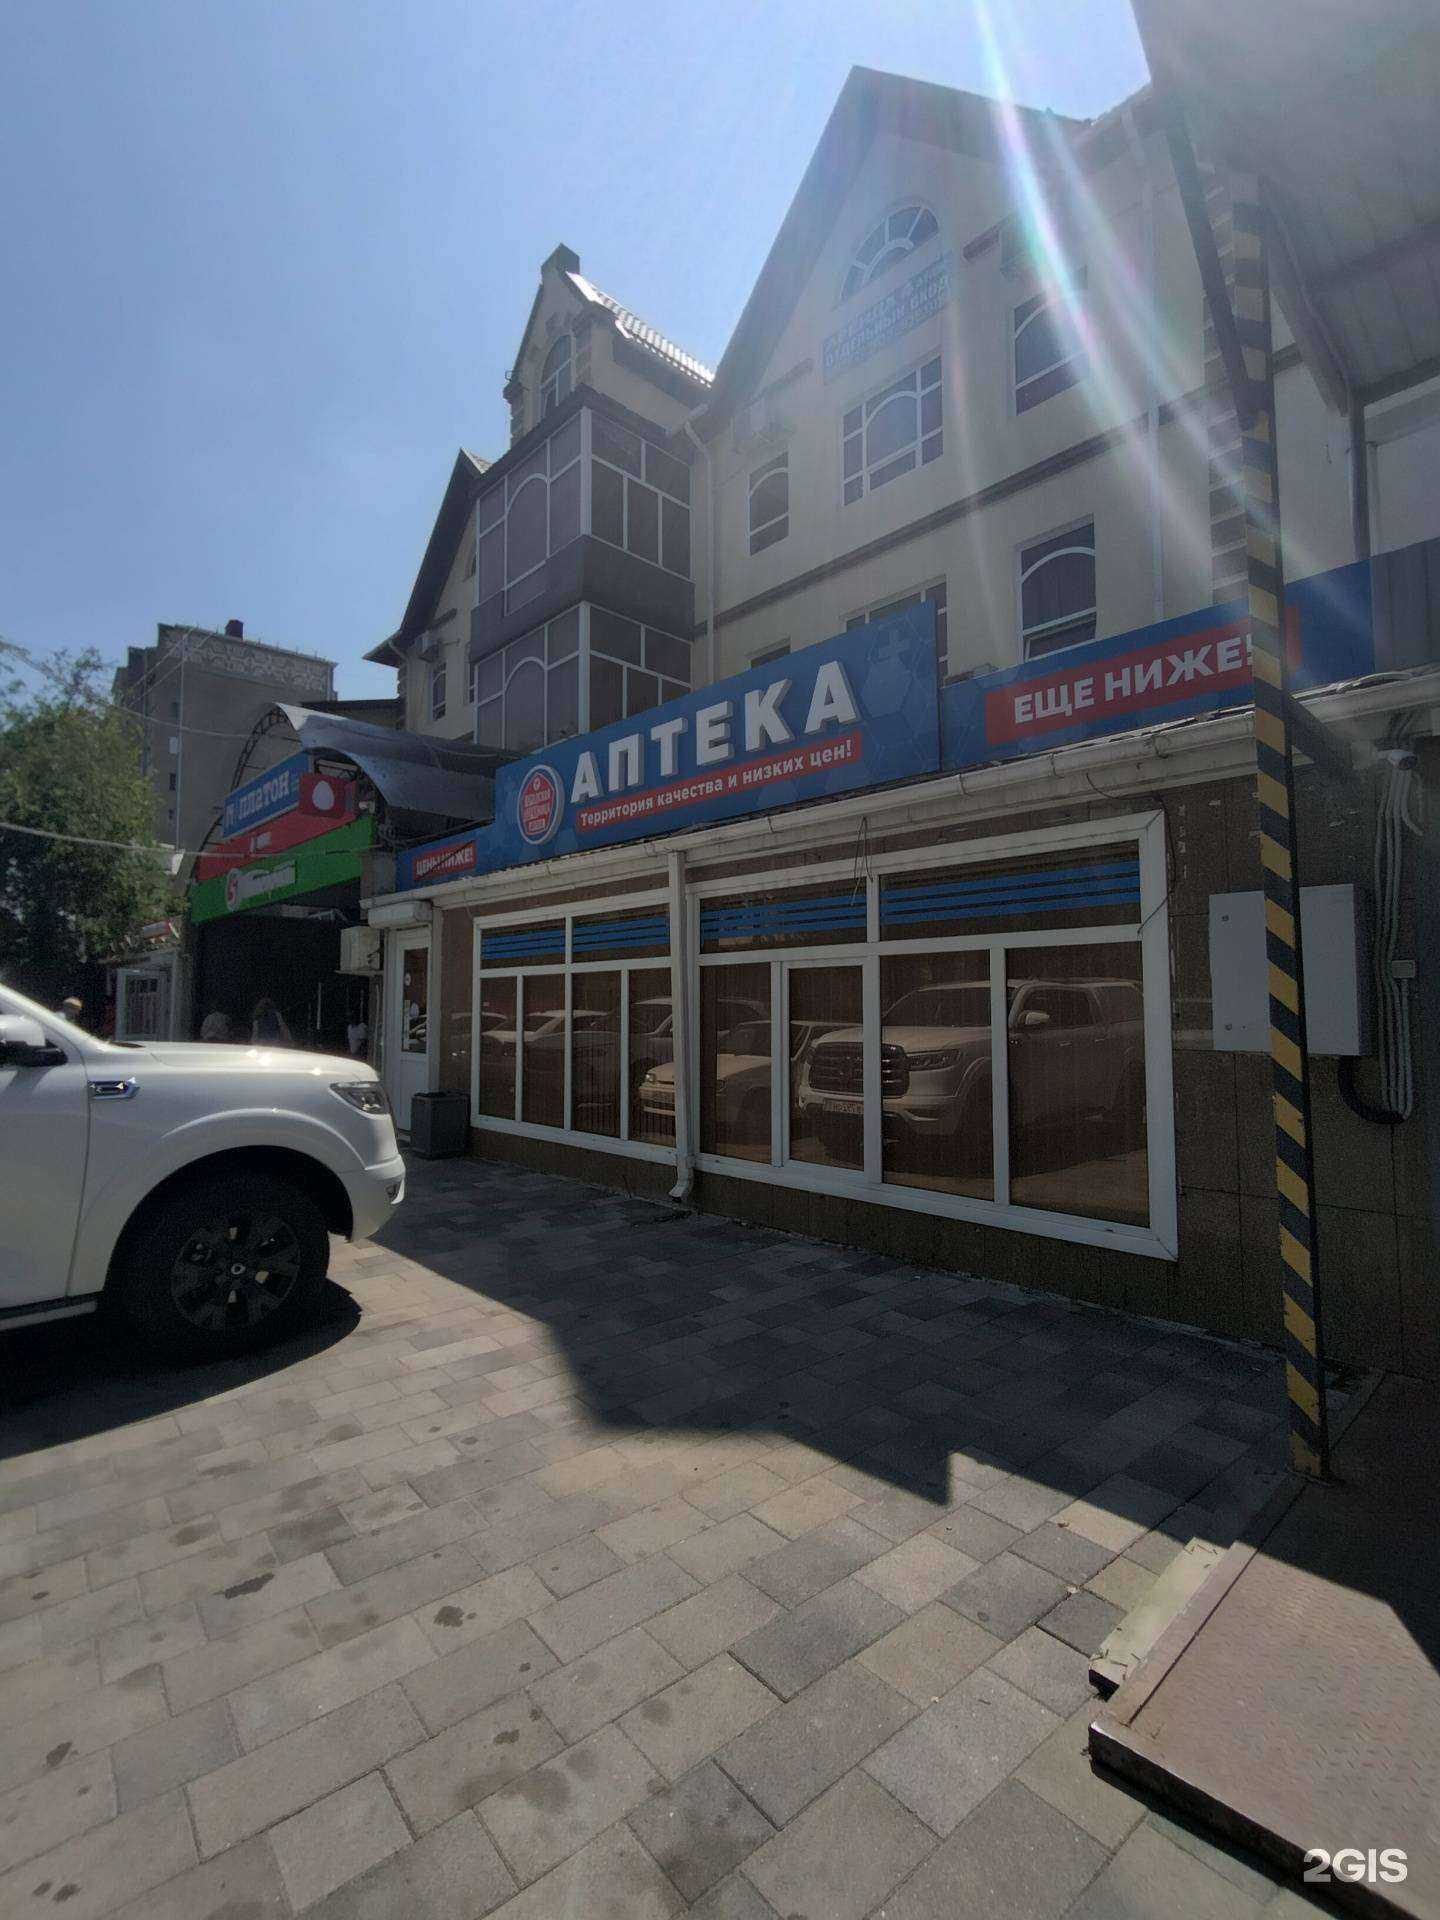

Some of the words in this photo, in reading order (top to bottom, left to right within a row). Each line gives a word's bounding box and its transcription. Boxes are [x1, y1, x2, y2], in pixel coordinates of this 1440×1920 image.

[571, 660, 862, 804] АПТЕКА
[1014, 677, 1095, 725] ЕЩЕ
[580, 795, 654, 827] Территория
[656, 777, 723, 808] качества
[728, 773, 738, 789] и
[742, 755, 804, 785] низких
[809, 739, 853, 769] цен!
